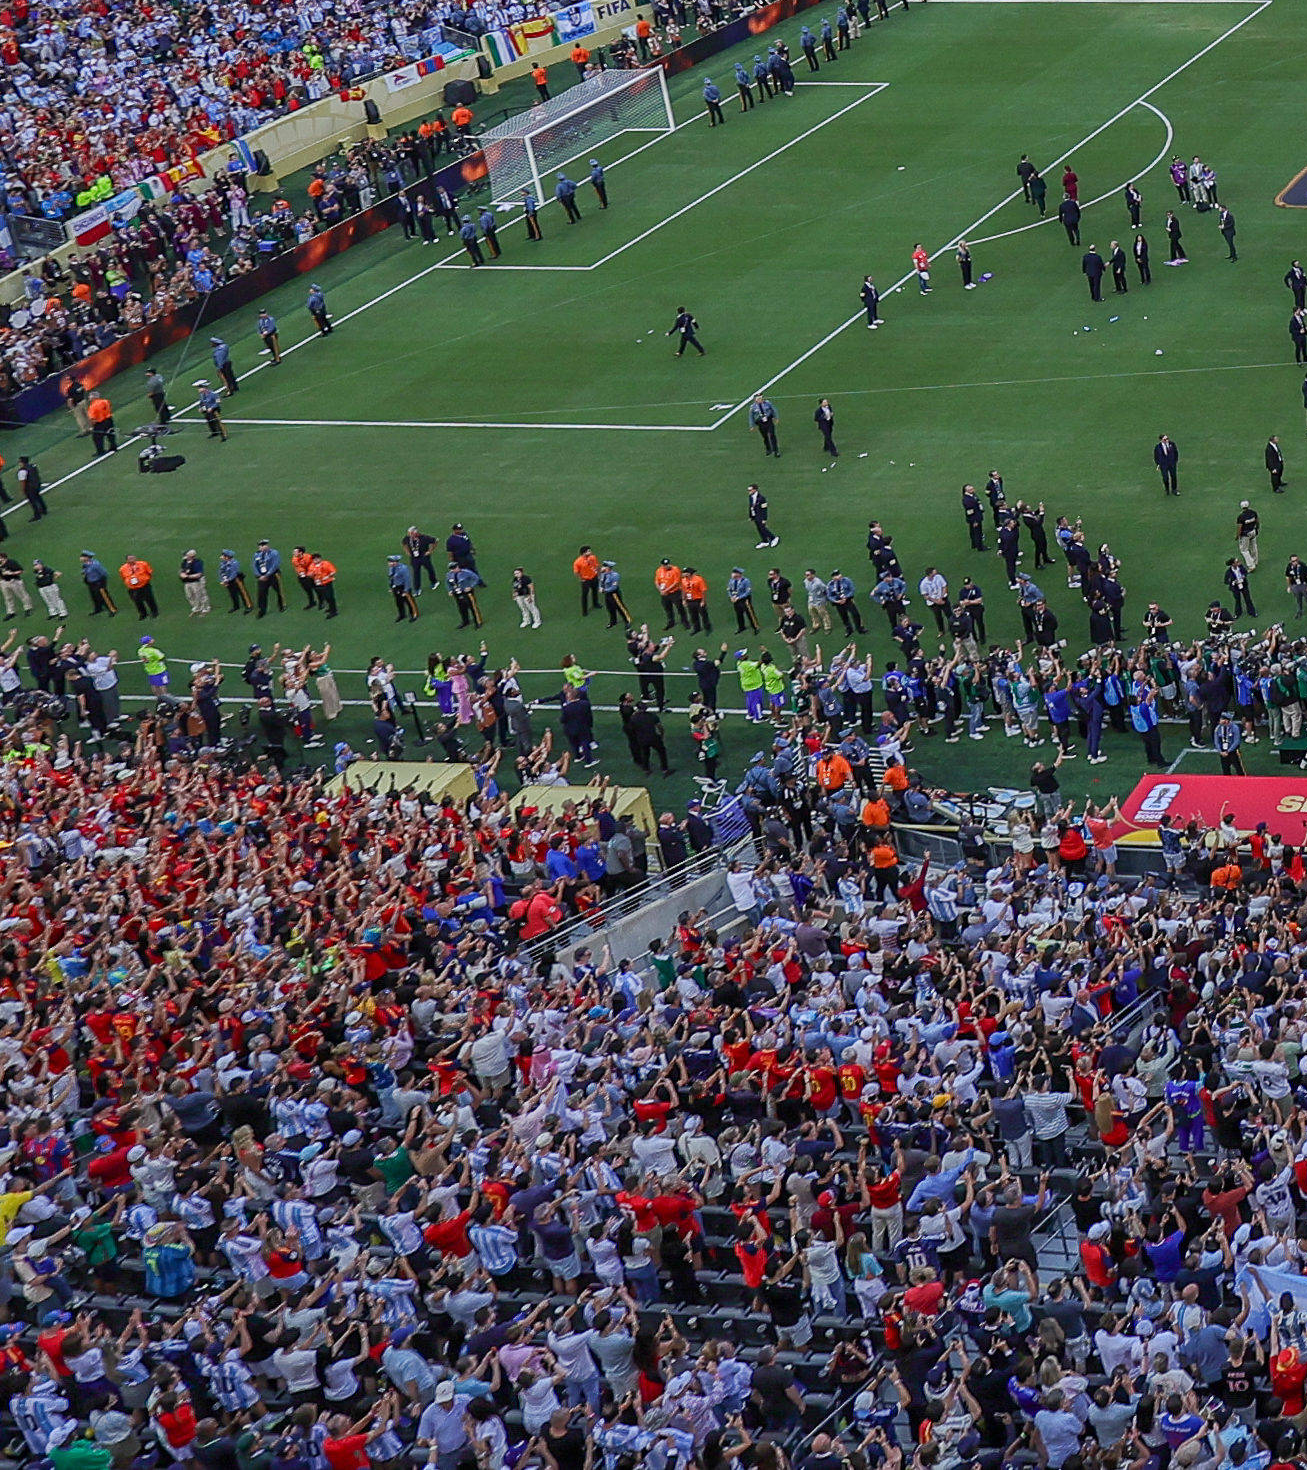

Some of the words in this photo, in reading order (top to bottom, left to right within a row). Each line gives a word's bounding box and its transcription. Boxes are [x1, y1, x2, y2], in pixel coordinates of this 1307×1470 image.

[597, 0, 631, 19] FIFA
[841, 1076, 856, 1092] 10
[905, 1253, 926, 1269] 10
[1228, 1379, 1249, 1393] 10
